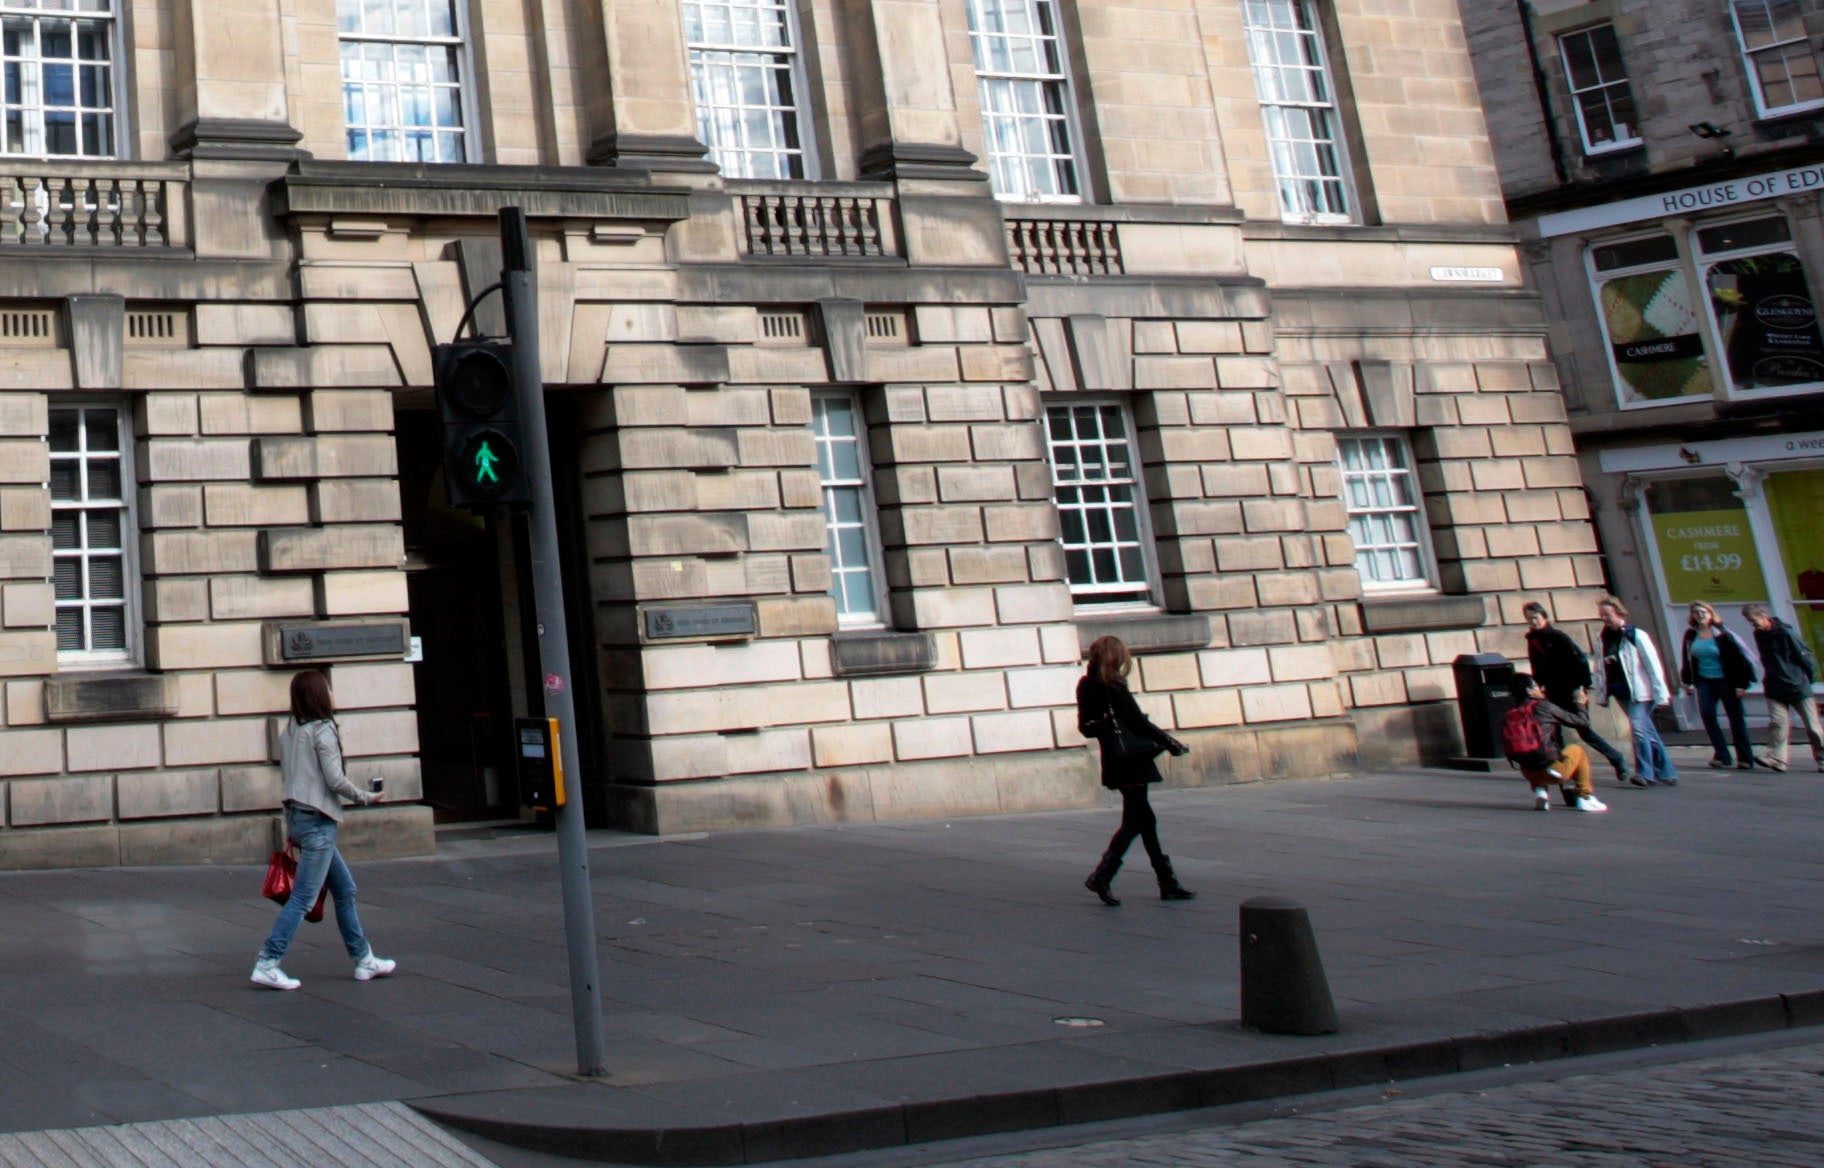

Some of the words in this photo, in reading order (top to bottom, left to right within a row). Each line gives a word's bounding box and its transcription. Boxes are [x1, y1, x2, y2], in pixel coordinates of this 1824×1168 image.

[1662, 185, 1738, 212] HOUSE
[1746, 177, 1776, 196] OF
[1785, 440, 1794, 451] a
[1667, 525, 1742, 540] CASHMERE
[1680, 552, 1743, 572] £14.99
